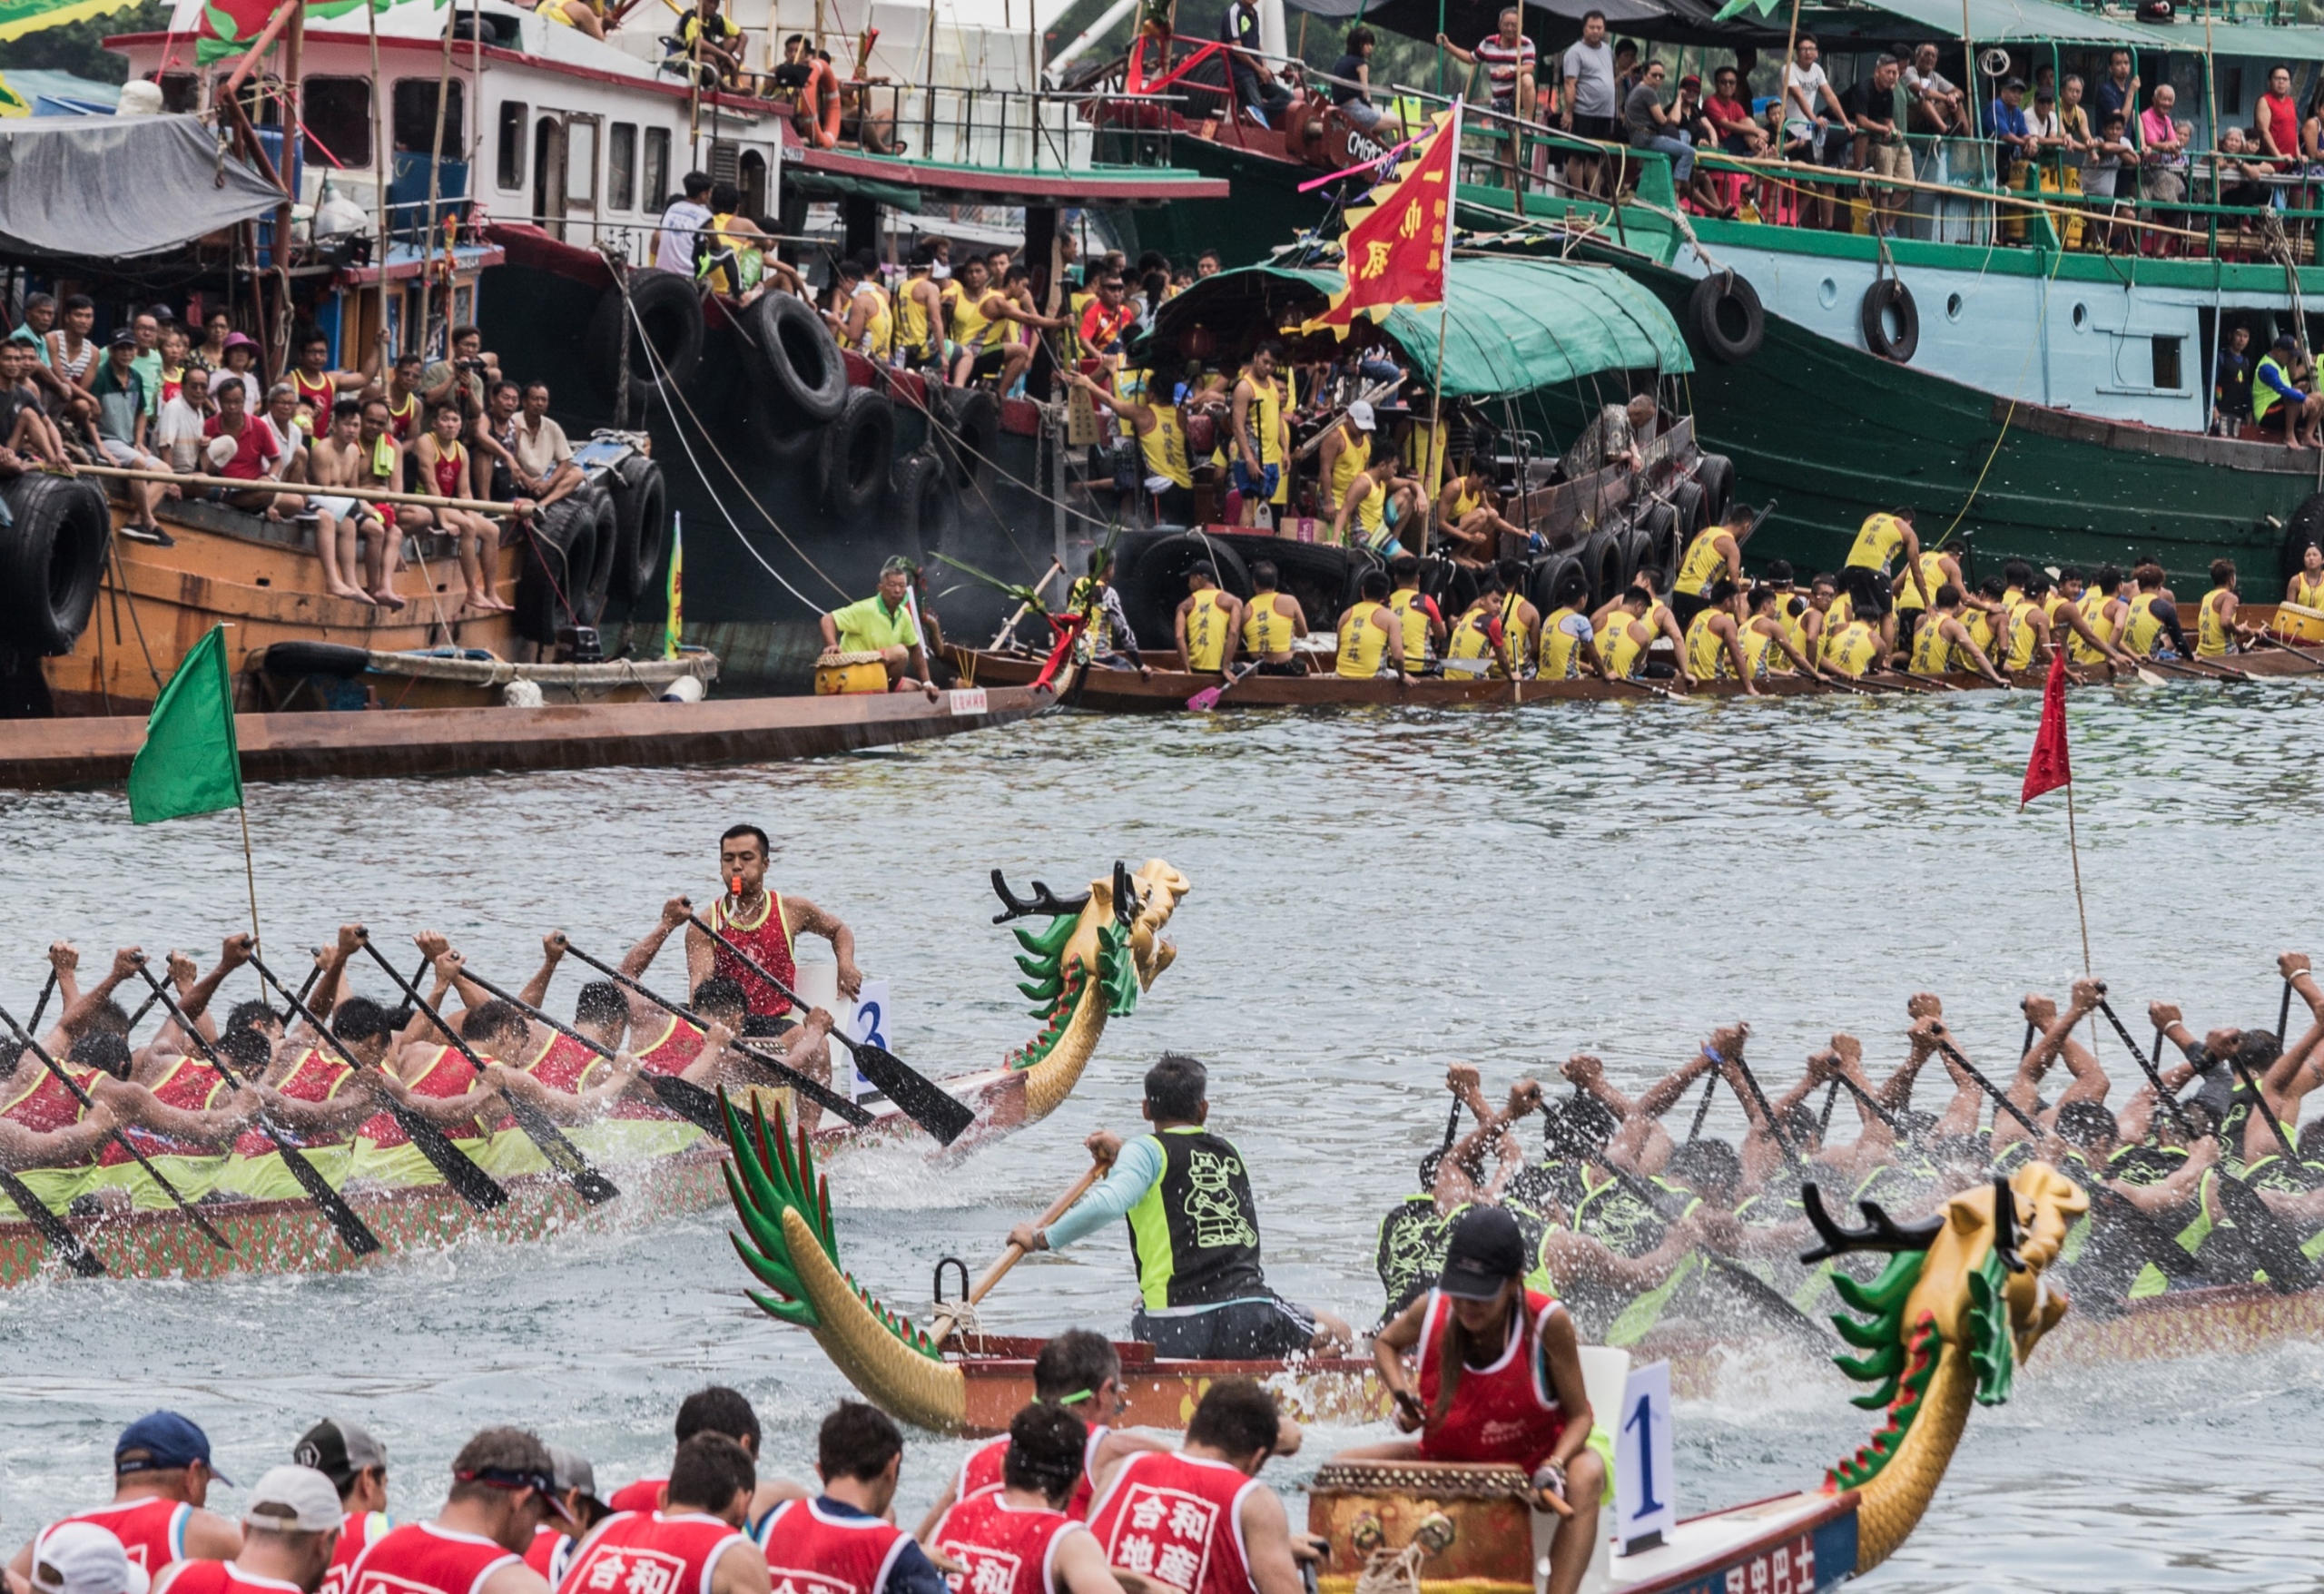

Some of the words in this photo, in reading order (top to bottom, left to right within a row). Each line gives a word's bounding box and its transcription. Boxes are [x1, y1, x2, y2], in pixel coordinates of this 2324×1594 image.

[857, 1001, 886, 1082] 3
[1625, 1394, 1664, 1520] 1
[1131, 1495, 1207, 1543] 合和
[588, 1555, 671, 1594] 合和
[1118, 1533, 1200, 1591] 地產
